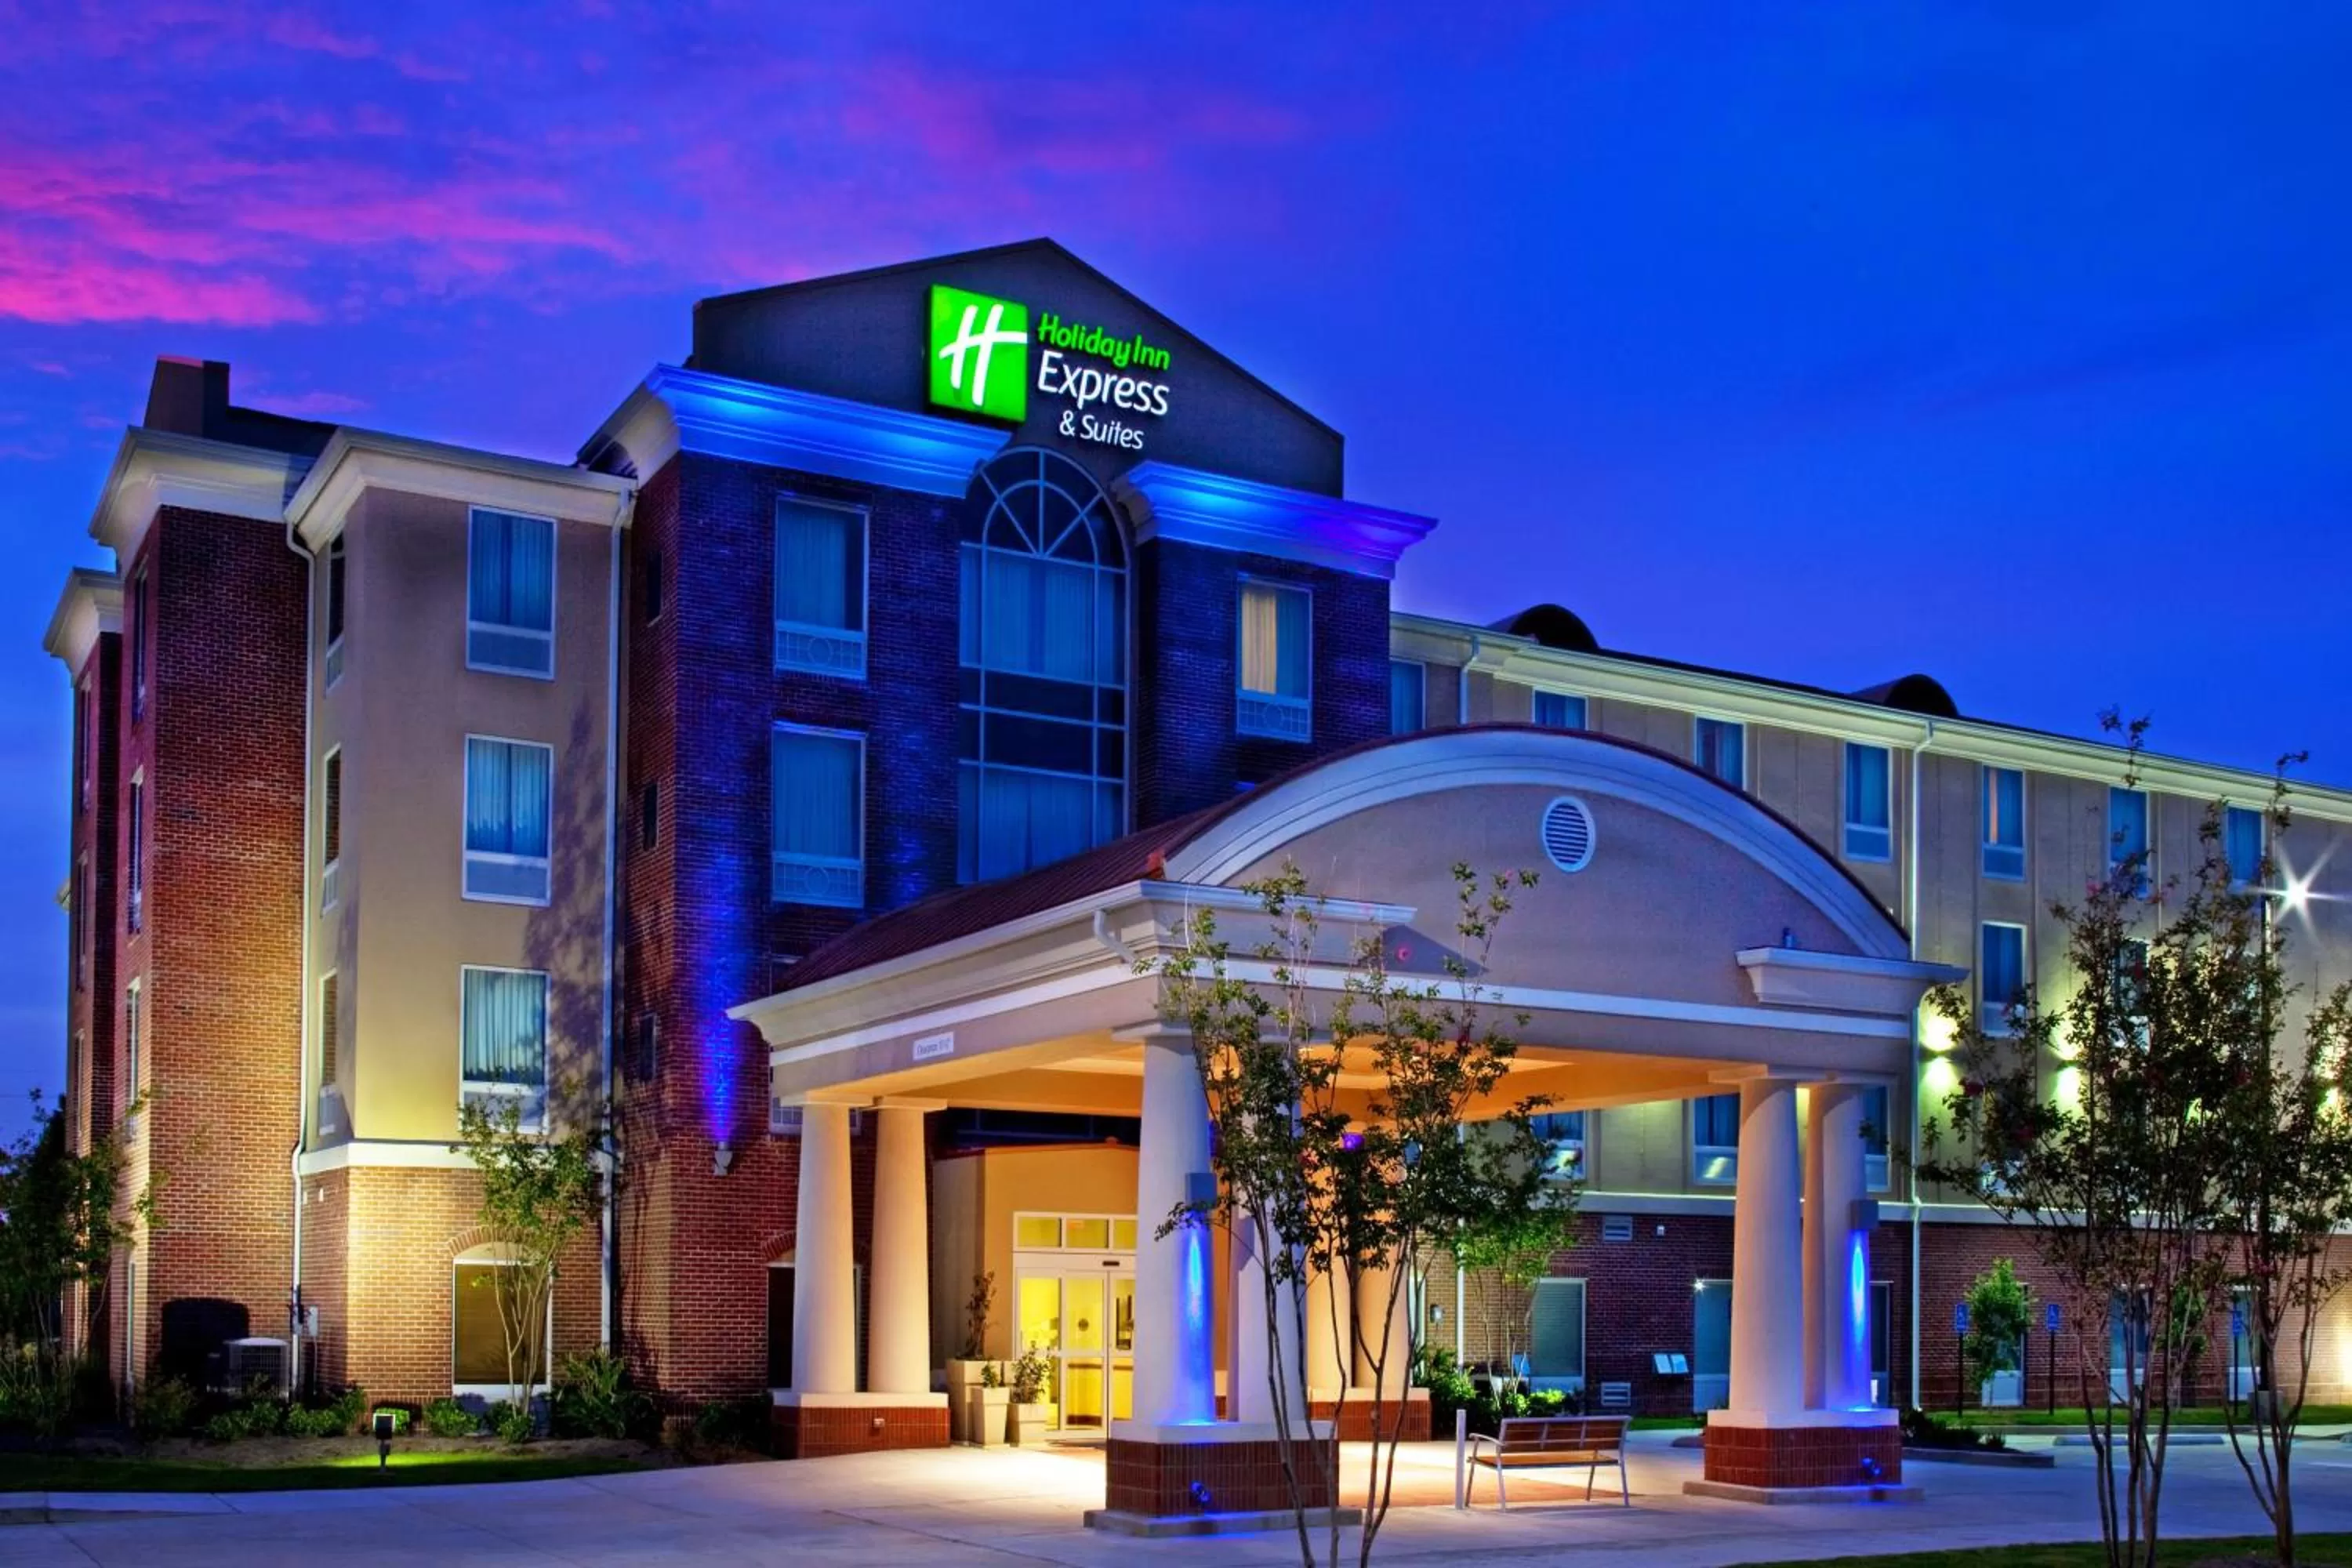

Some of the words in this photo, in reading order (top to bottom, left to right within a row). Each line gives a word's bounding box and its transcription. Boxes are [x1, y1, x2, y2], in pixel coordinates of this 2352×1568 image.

[1037, 312, 1131, 368] Holiday
[1132, 335, 1171, 370] Inn
[1037, 350, 1170, 416] Express
[1059, 410, 1076, 437] &
[1080, 415, 1144, 449] Suites
